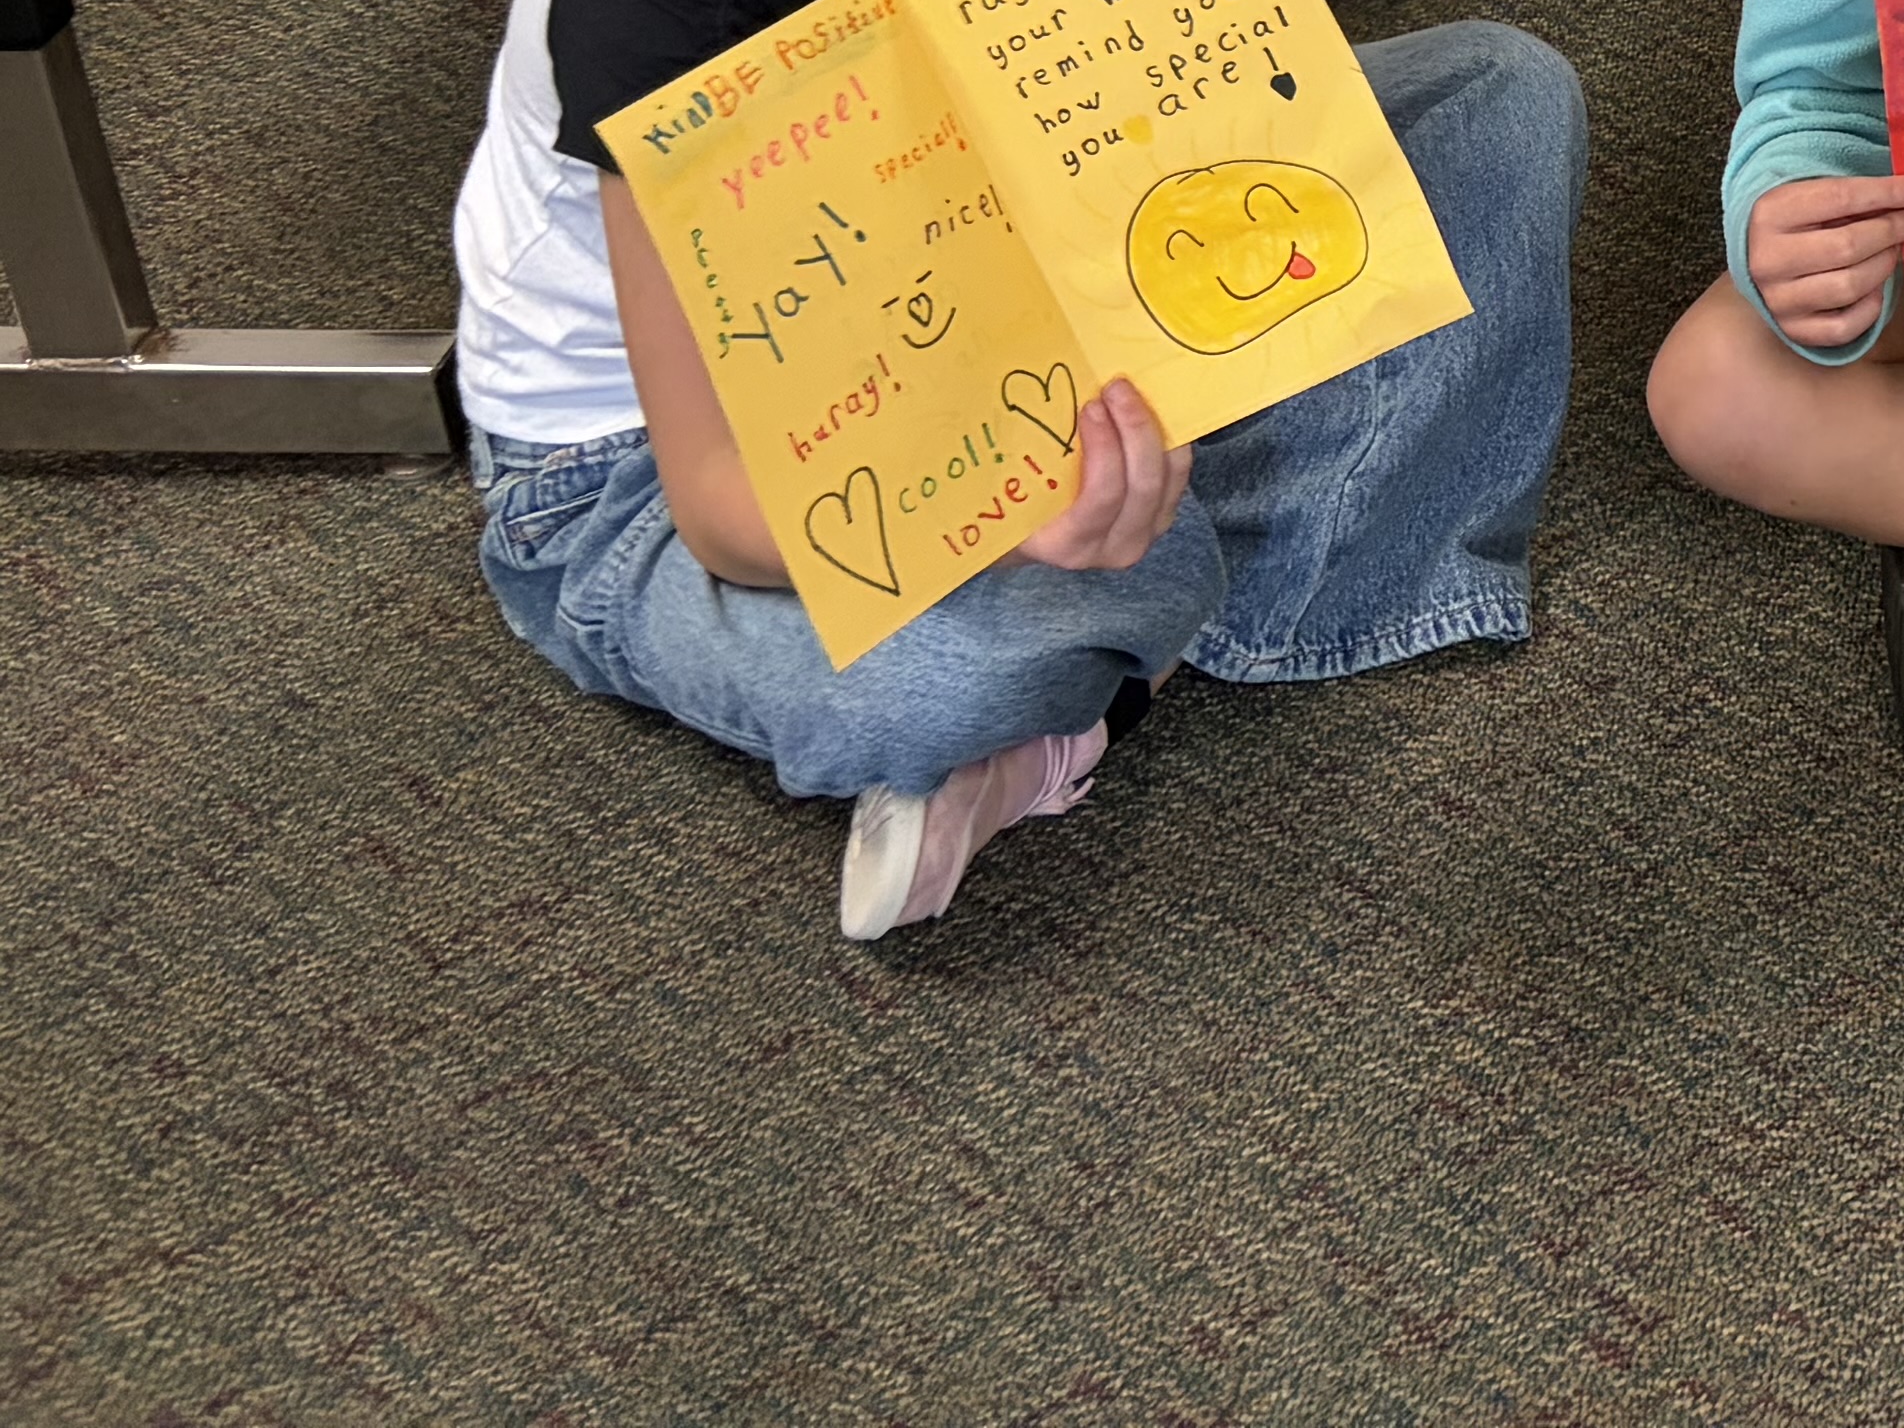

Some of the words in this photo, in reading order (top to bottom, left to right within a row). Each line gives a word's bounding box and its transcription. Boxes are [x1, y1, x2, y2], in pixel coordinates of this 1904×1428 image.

[987, 8, 1068, 71] your
[1015, 19, 1145, 99] remind
[1033, 91, 1101, 134] how
[1146, 5, 1290, 88] special
[1062, 127, 1125, 176] you
[924, 183, 1013, 245] nice!
[898, 421, 1007, 514] cool!
[942, 454, 1059, 557] love!
